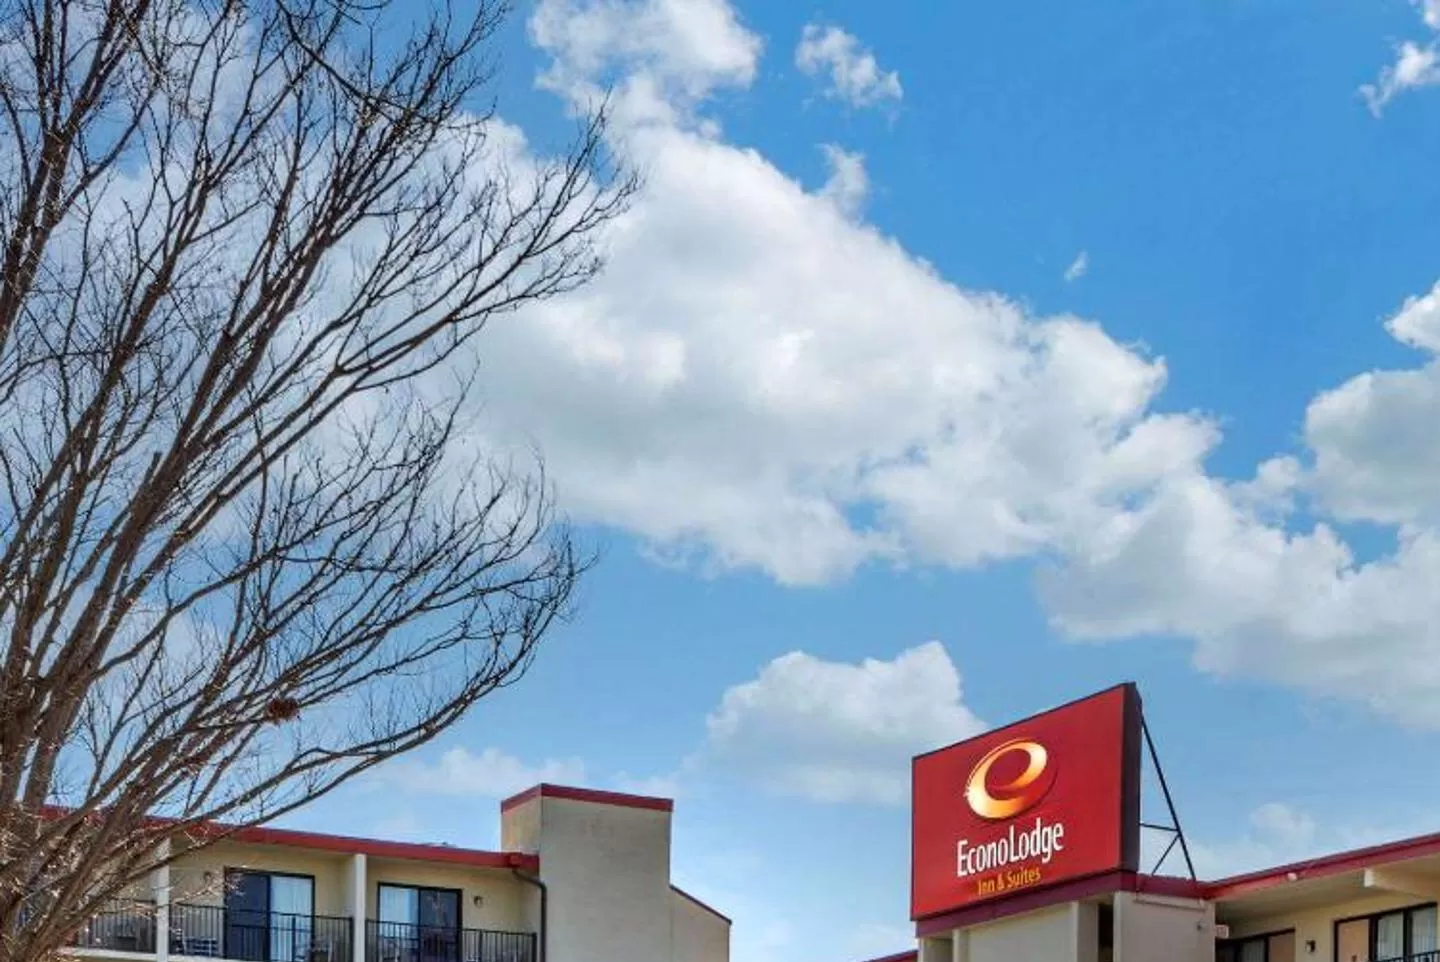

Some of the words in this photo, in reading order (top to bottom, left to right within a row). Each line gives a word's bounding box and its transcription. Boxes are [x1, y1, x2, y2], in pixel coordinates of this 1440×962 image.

[957, 818, 1064, 878] EconoLodge
[978, 879, 995, 896] Inn
[997, 874, 1004, 891] &
[1007, 868, 1041, 889] Suites
